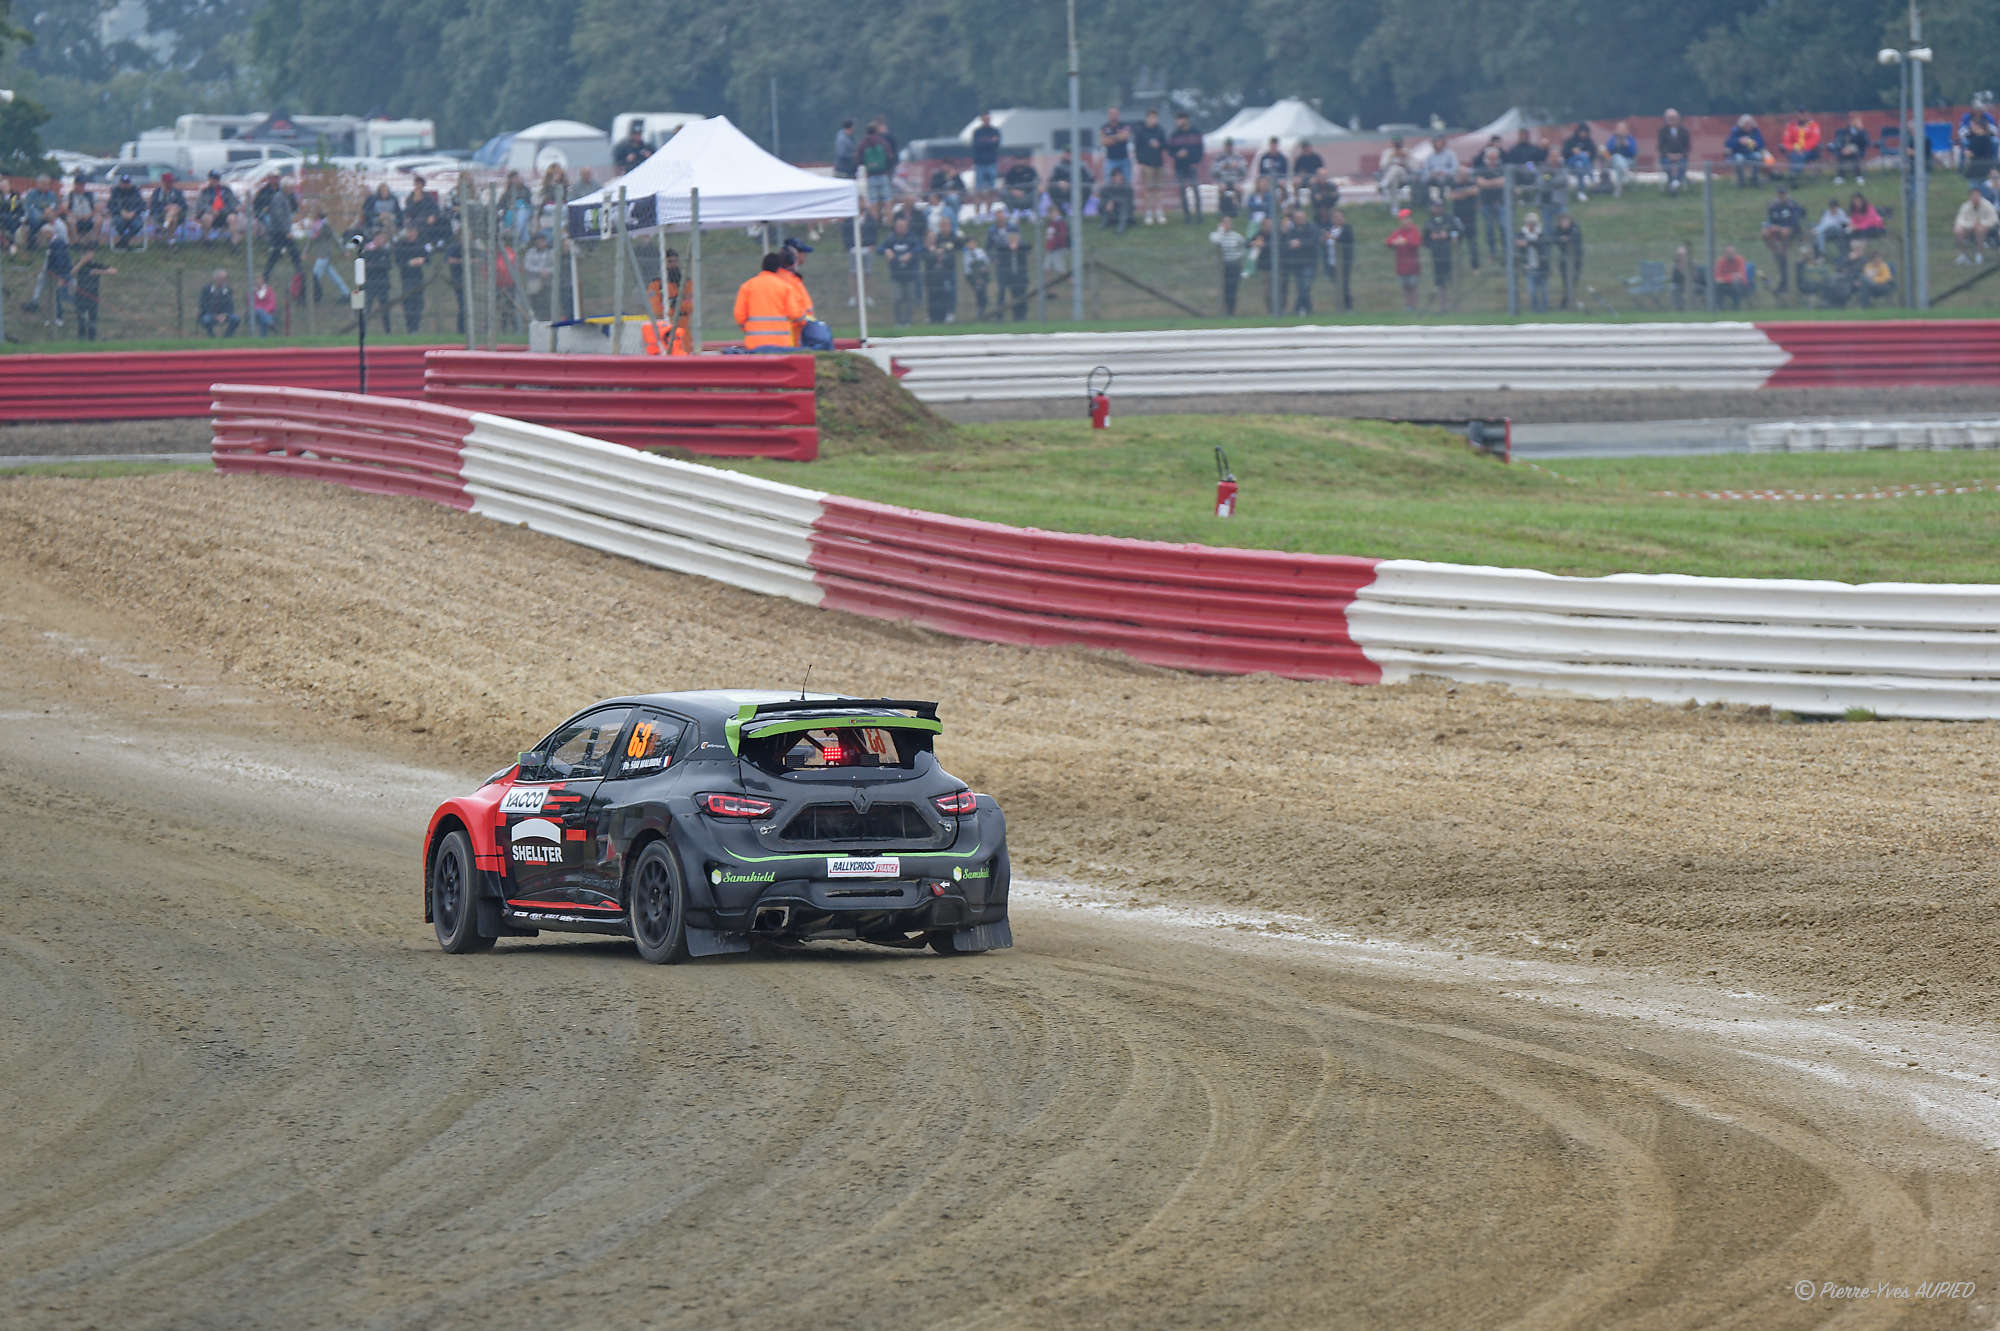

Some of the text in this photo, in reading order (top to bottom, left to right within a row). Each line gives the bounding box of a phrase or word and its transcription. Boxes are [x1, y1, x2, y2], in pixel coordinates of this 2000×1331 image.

[627, 722, 653, 758] 63
[506, 792, 544, 808] YACCO
[512, 845, 563, 863] SHELLTER
[833, 861, 876, 871] RALLYCROSS
[723, 871, 775, 883] Samshield
